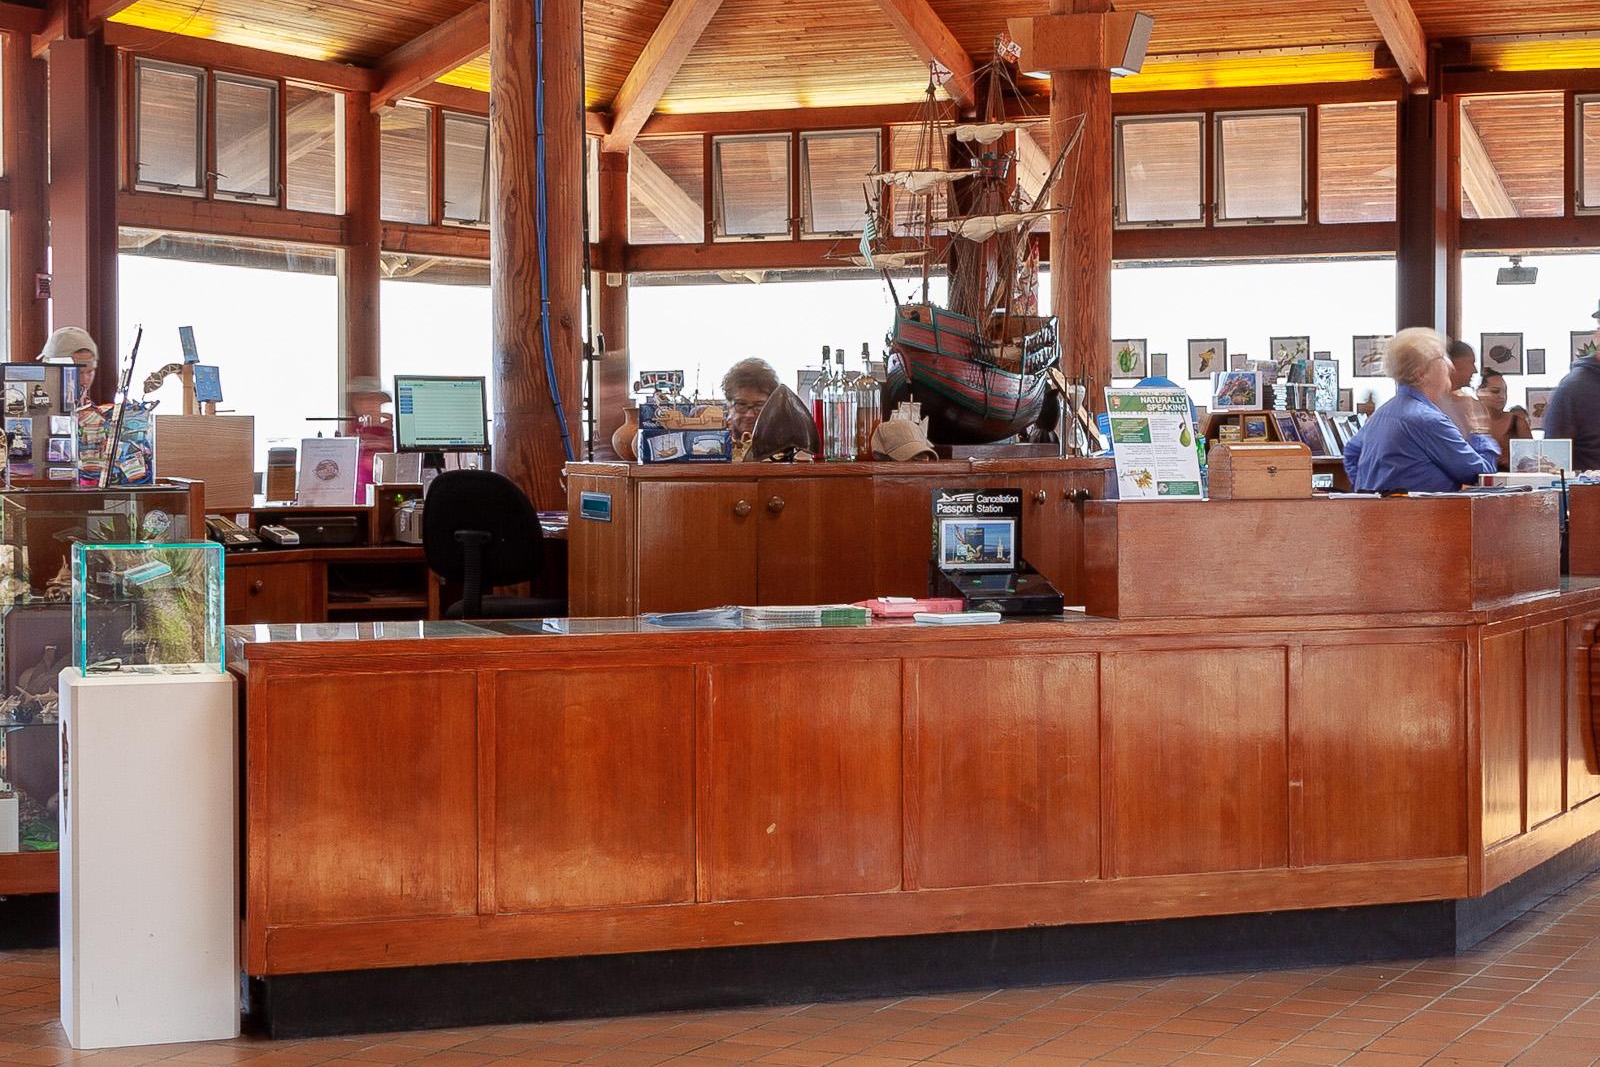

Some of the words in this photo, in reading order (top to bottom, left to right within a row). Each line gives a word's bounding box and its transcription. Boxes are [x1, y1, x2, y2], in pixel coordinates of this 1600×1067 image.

[1140, 396, 1186, 404] NATURALLY
[976, 495, 1018, 503] Cancellation
[936, 504, 973, 514] Passport
[976, 504, 1003, 513] Station
